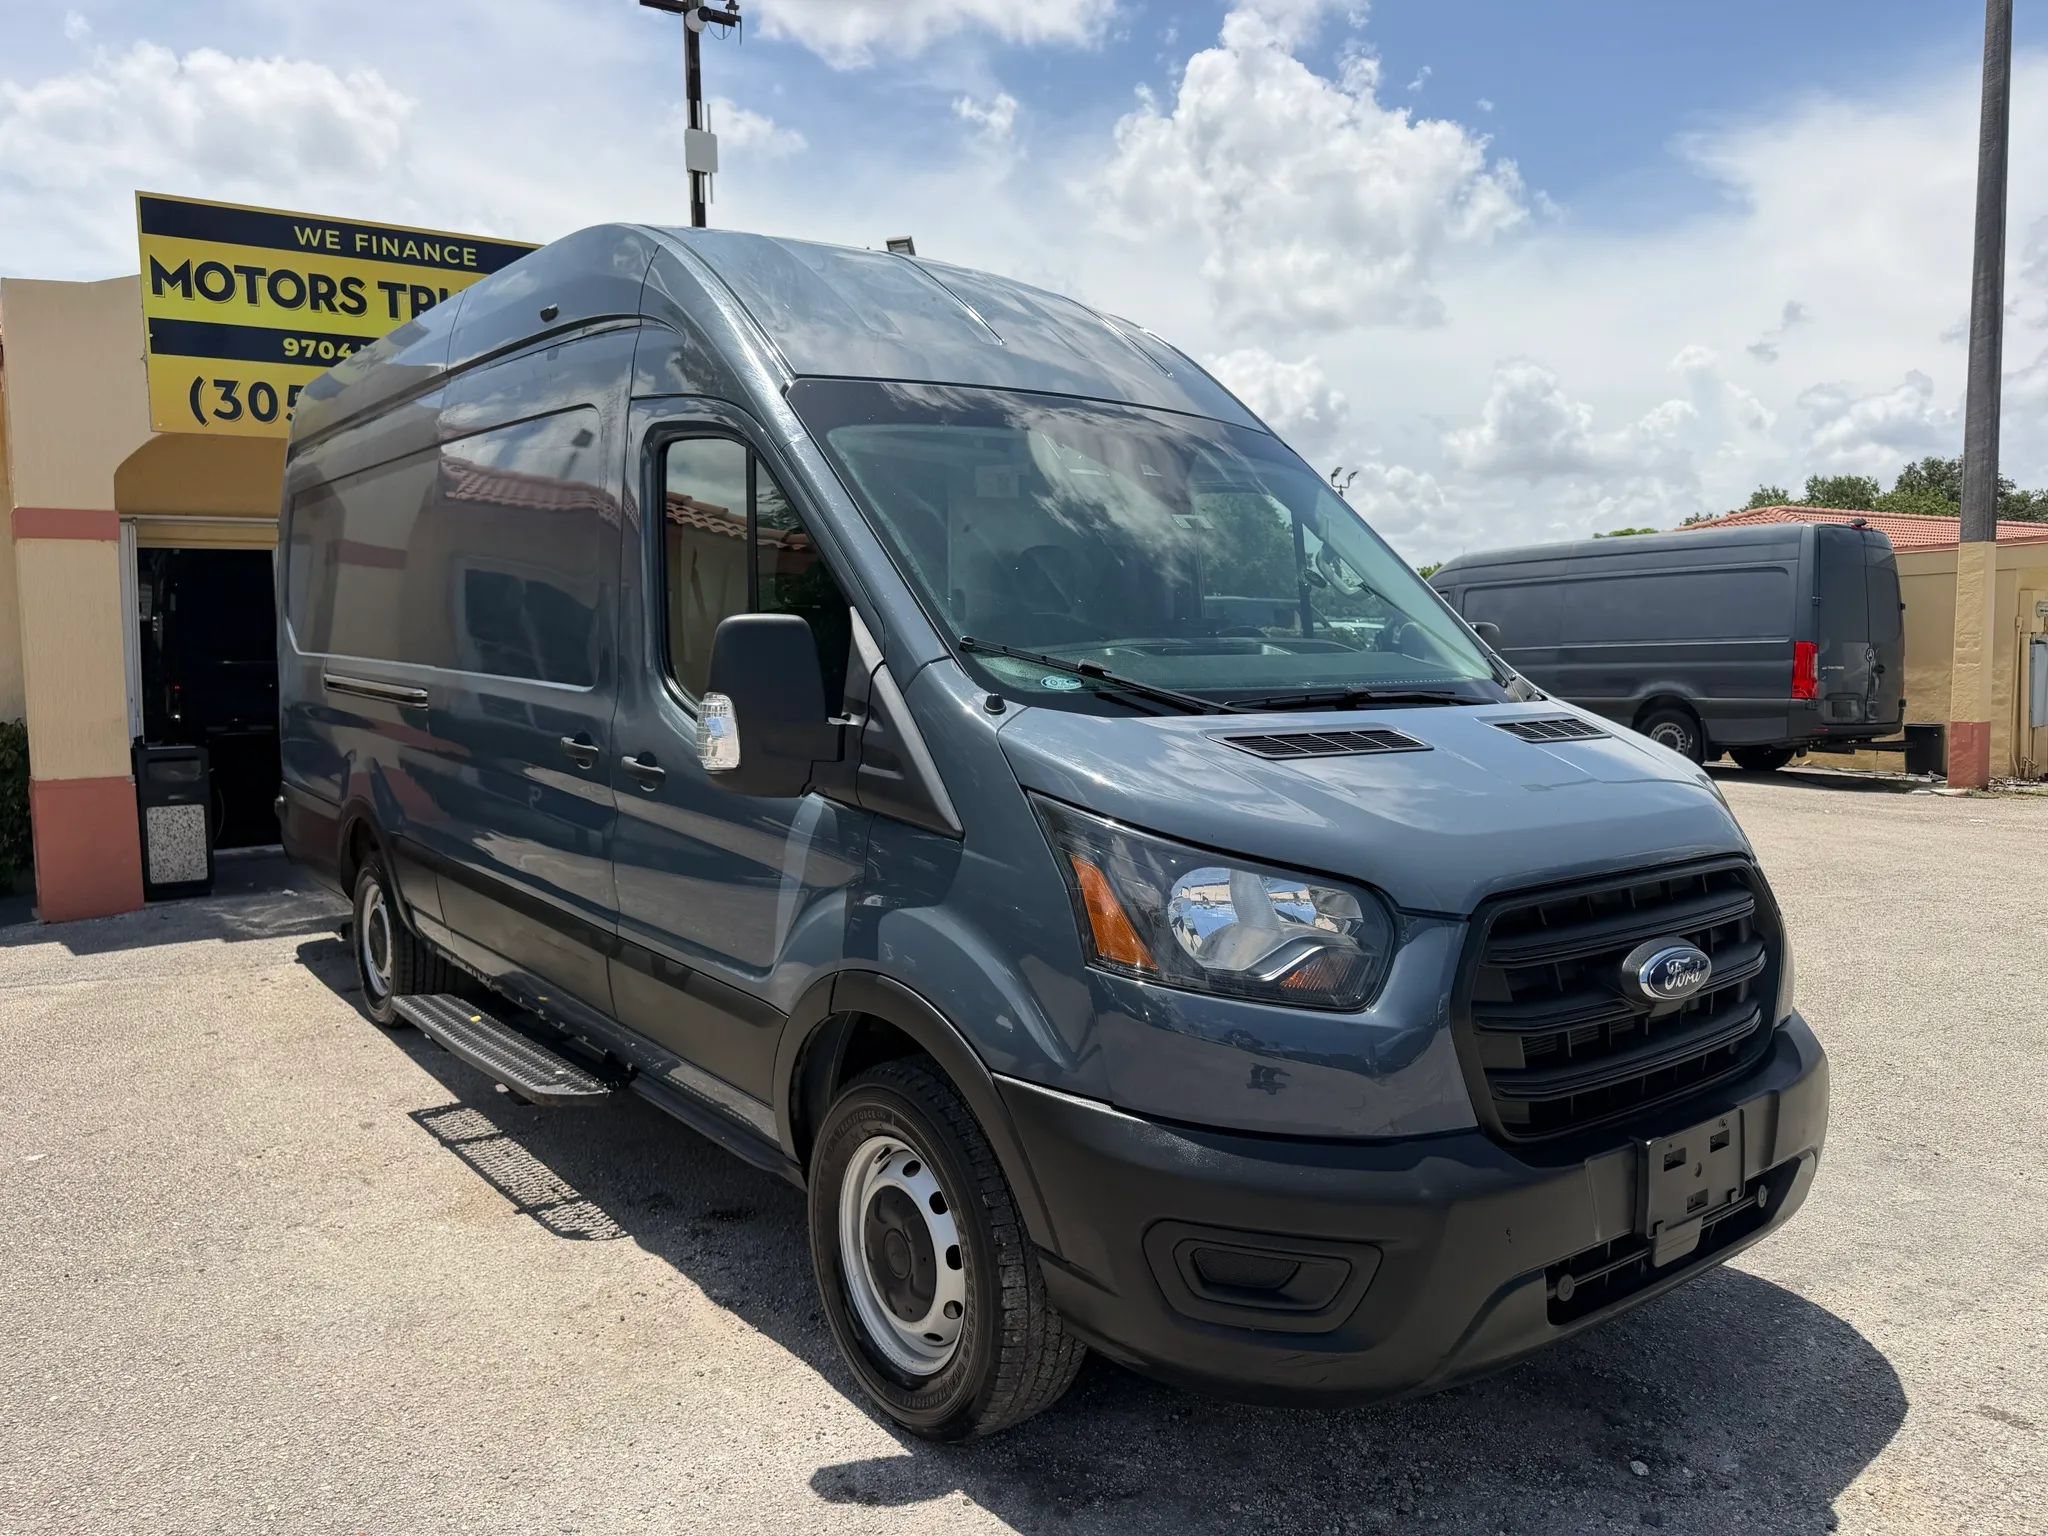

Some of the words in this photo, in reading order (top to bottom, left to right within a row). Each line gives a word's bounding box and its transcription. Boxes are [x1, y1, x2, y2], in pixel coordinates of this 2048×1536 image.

[294, 226, 341, 249] WE
[355, 233, 477, 266] FINANCE
[149, 254, 369, 318] MOTORS
[377, 280, 460, 321] TR
[282, 338, 352, 360] 9704
[1664, 956, 1702, 990] Ford
